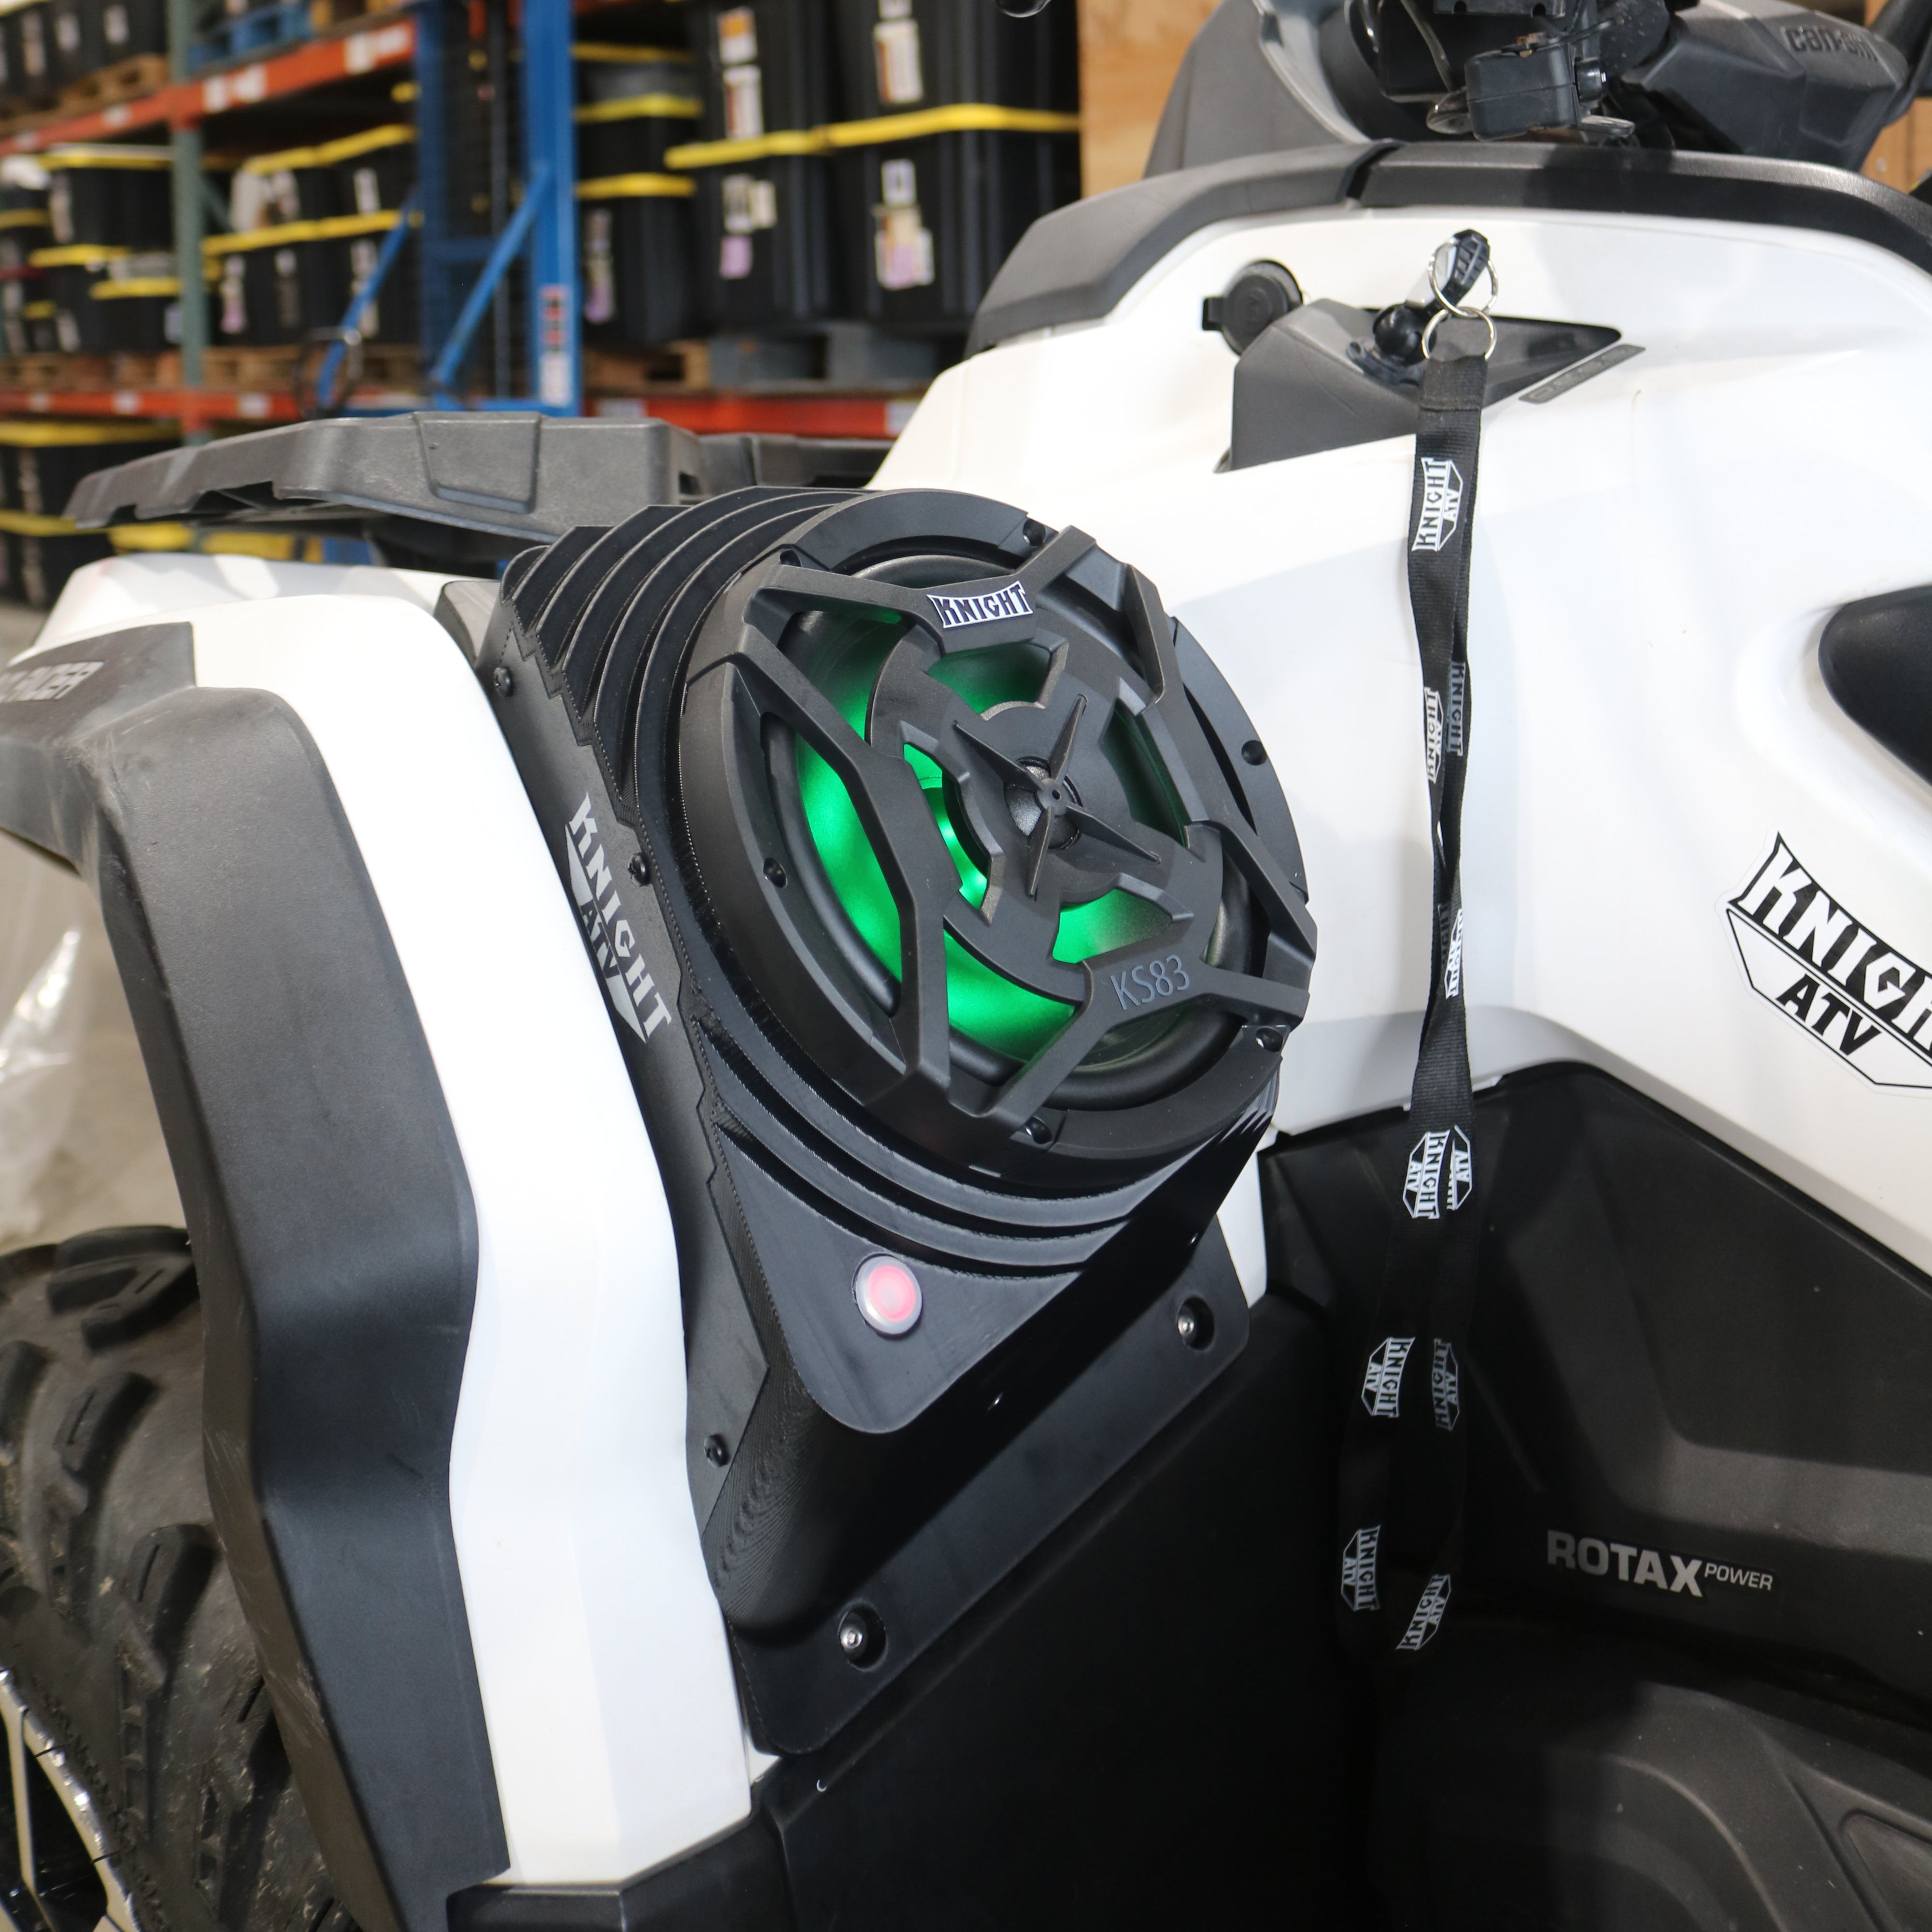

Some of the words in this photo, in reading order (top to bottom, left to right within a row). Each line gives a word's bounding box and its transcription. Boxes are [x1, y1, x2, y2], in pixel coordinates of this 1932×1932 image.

[1413, 458, 1448, 549] KNIGHT
[1443, 488, 1459, 522] ATV
[929, 582, 1031, 627] KNIGHT
[1450, 663, 1465, 753] KNIGHT
[569, 793, 672, 1038] KNIGHT
[580, 904, 620, 979] ATV
[1110, 954, 1190, 1010] KS83
[1776, 973, 1882, 1056] ATV
[1406, 1160, 1423, 1193] ATV
[1418, 1135, 1447, 1216] KNIGHT
[1454, 1149, 1470, 1183] ATV
[1365, 1362, 1382, 1392] ATV
[1376, 1340, 1412, 1416] KNIGHT
[1432, 1342, 1449, 1425] KNIGHT
[1446, 1371, 1457, 1406] ATV
[1344, 1557, 1357, 1586] ATV
[1358, 1528, 1378, 1609] KNIGHT
[1548, 1530, 1703, 1597] ROTAX
[1705, 1563, 1774, 1591] POWER
[1400, 1576, 1445, 1648] KNIGHT
[1428, 1595, 1446, 1625] ATV
